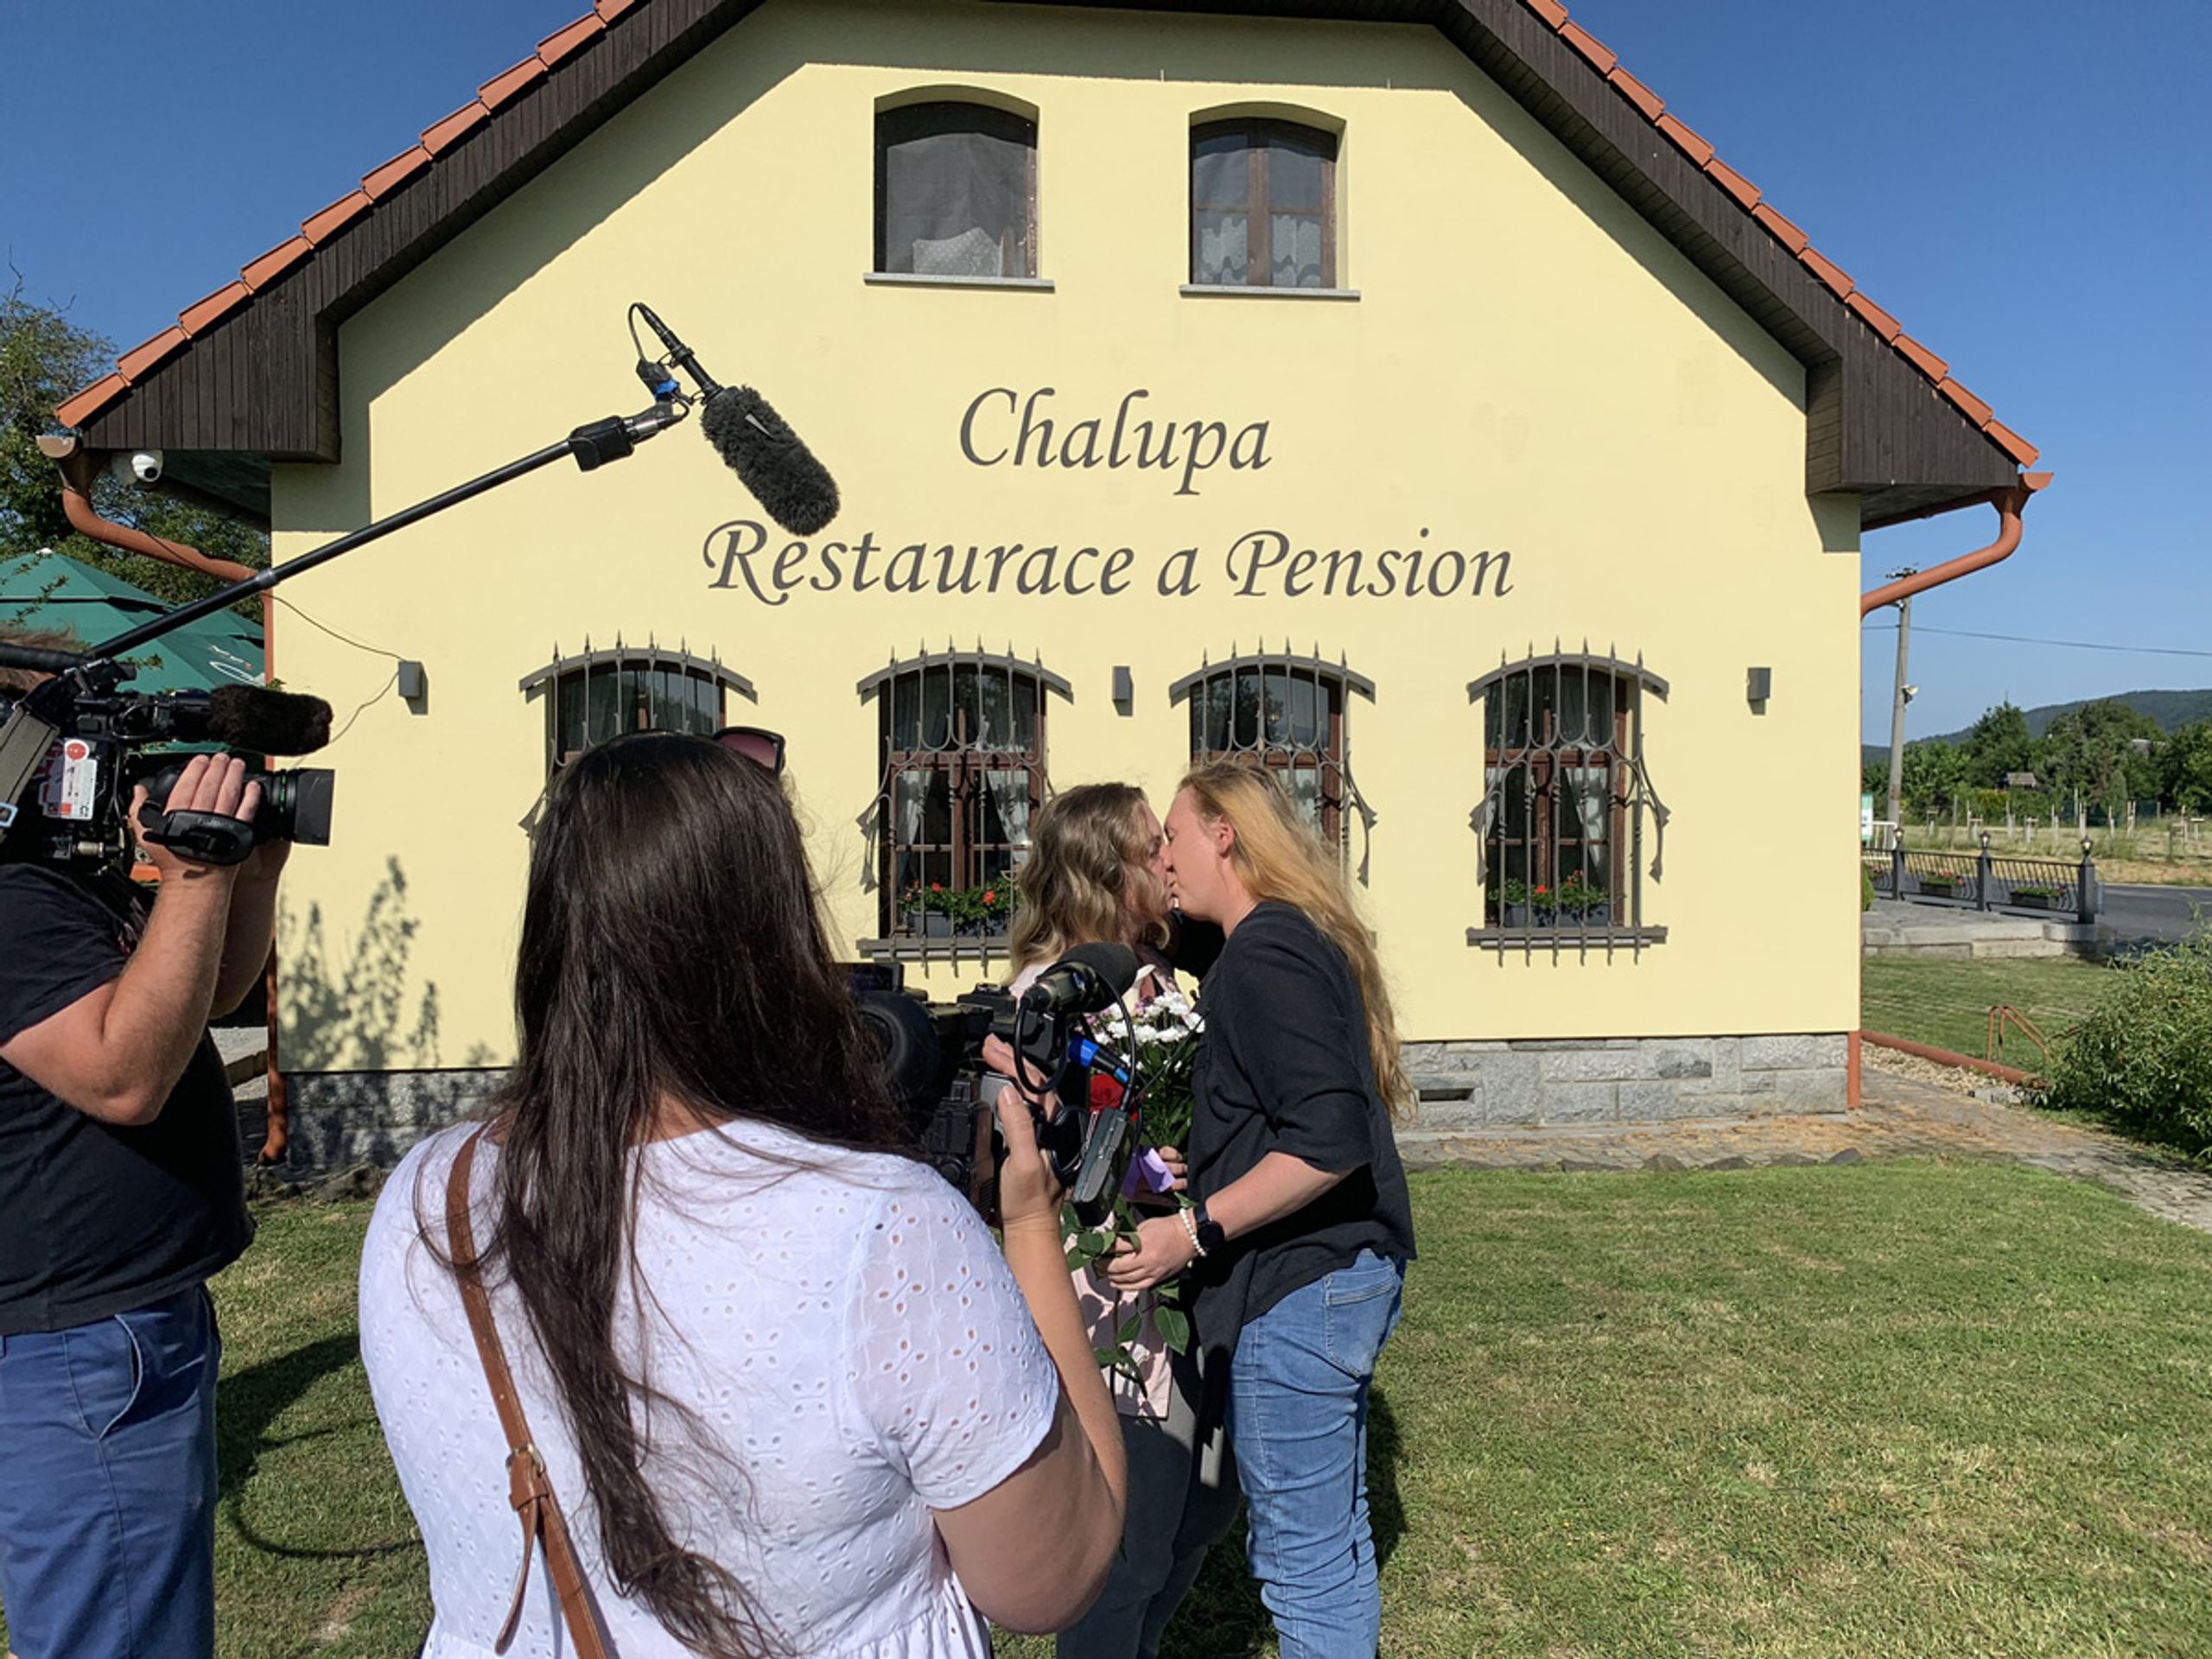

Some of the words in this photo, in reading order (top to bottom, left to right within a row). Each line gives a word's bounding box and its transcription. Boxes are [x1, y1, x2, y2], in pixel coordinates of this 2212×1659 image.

[960, 387, 1273, 496] Chalupa
[702, 519, 1135, 607] Restaurace
[1157, 547, 1201, 597] a
[1225, 528, 1514, 598] Pension
